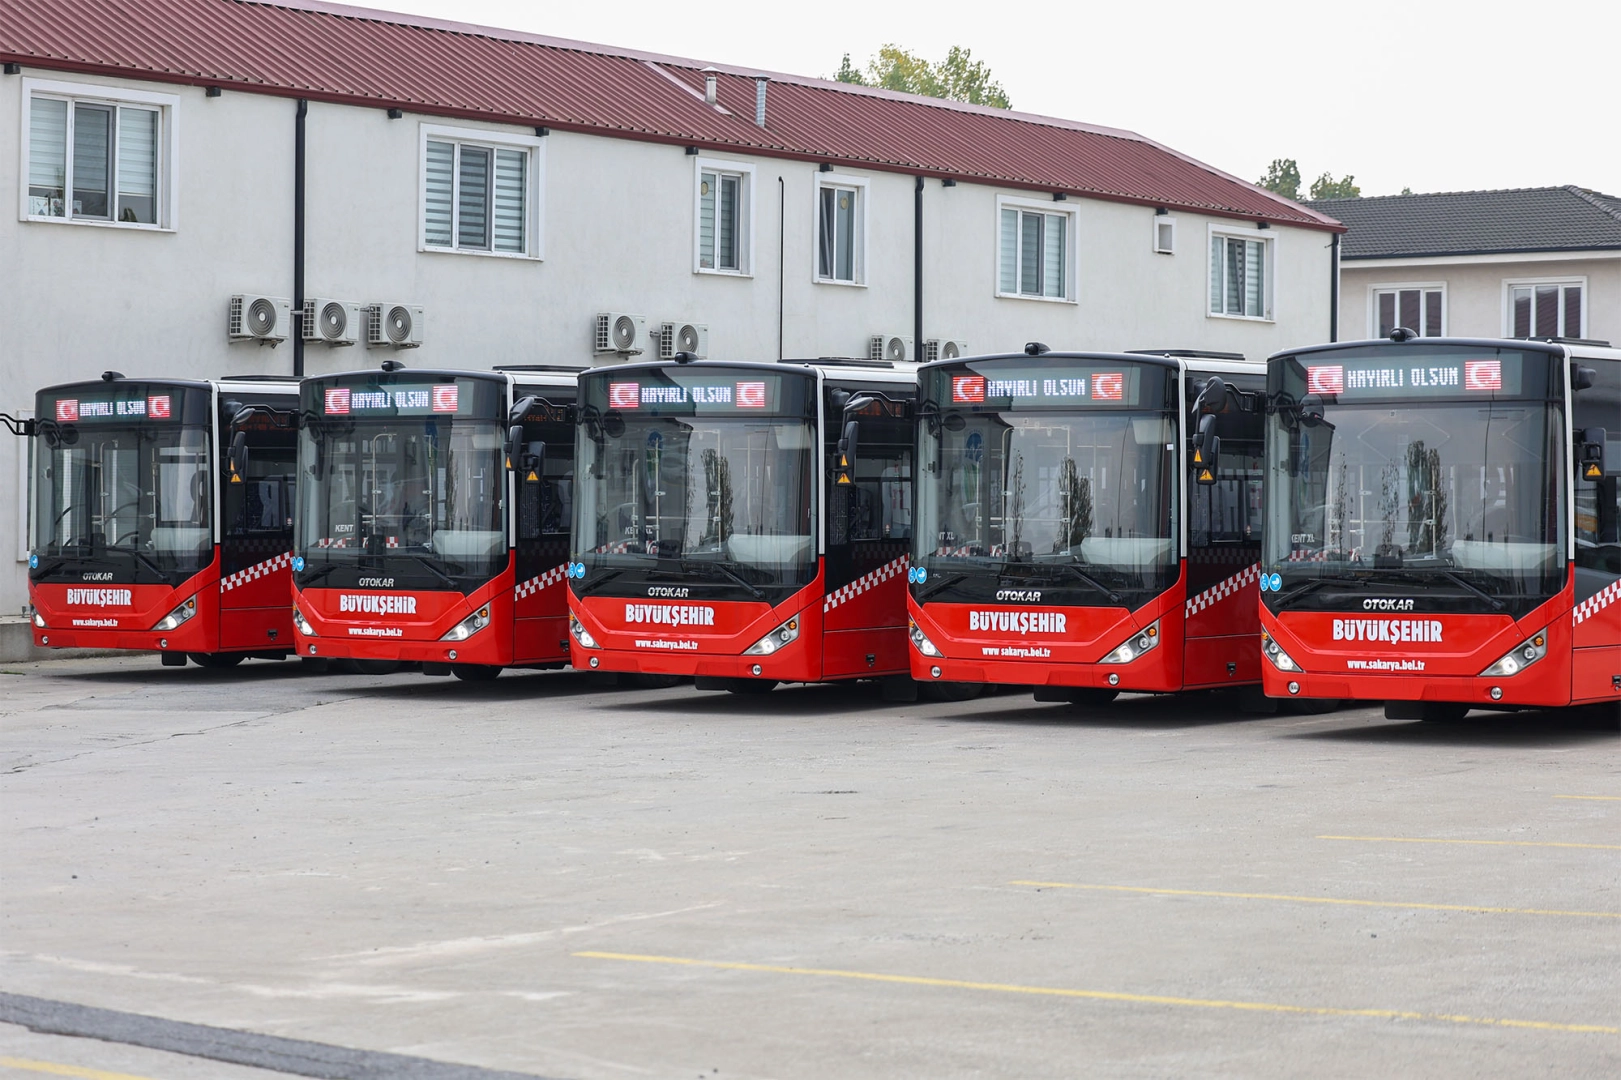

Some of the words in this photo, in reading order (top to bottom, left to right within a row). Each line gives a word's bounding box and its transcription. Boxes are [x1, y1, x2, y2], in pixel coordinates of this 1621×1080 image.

[1348, 369, 1404, 389] HAYIRLI
[1410, 367, 1458, 387] OLSUN
[987, 379, 1037, 397] HAYIRLI
[1043, 378, 1085, 396] OLSUN
[351, 391, 390, 409] HAYIRLI
[395, 390, 428, 407] OLSUN
[641, 386, 687, 403] HAYIRLI
[693, 386, 731, 403] OLSUN
[82, 572, 113, 581] OTOKAR
[358, 578, 395, 588] OTOKAR
[647, 587, 689, 598] OTOKAR
[996, 591, 1042, 602] OTOKAR
[1362, 598, 1414, 611] OTOKAR
[348, 627, 402, 637] www.sakarya.bel.tr
[635, 639, 698, 650] www.sakarya.bel.tr
[1346, 658, 1425, 672] www.sakarya.bel.tr
